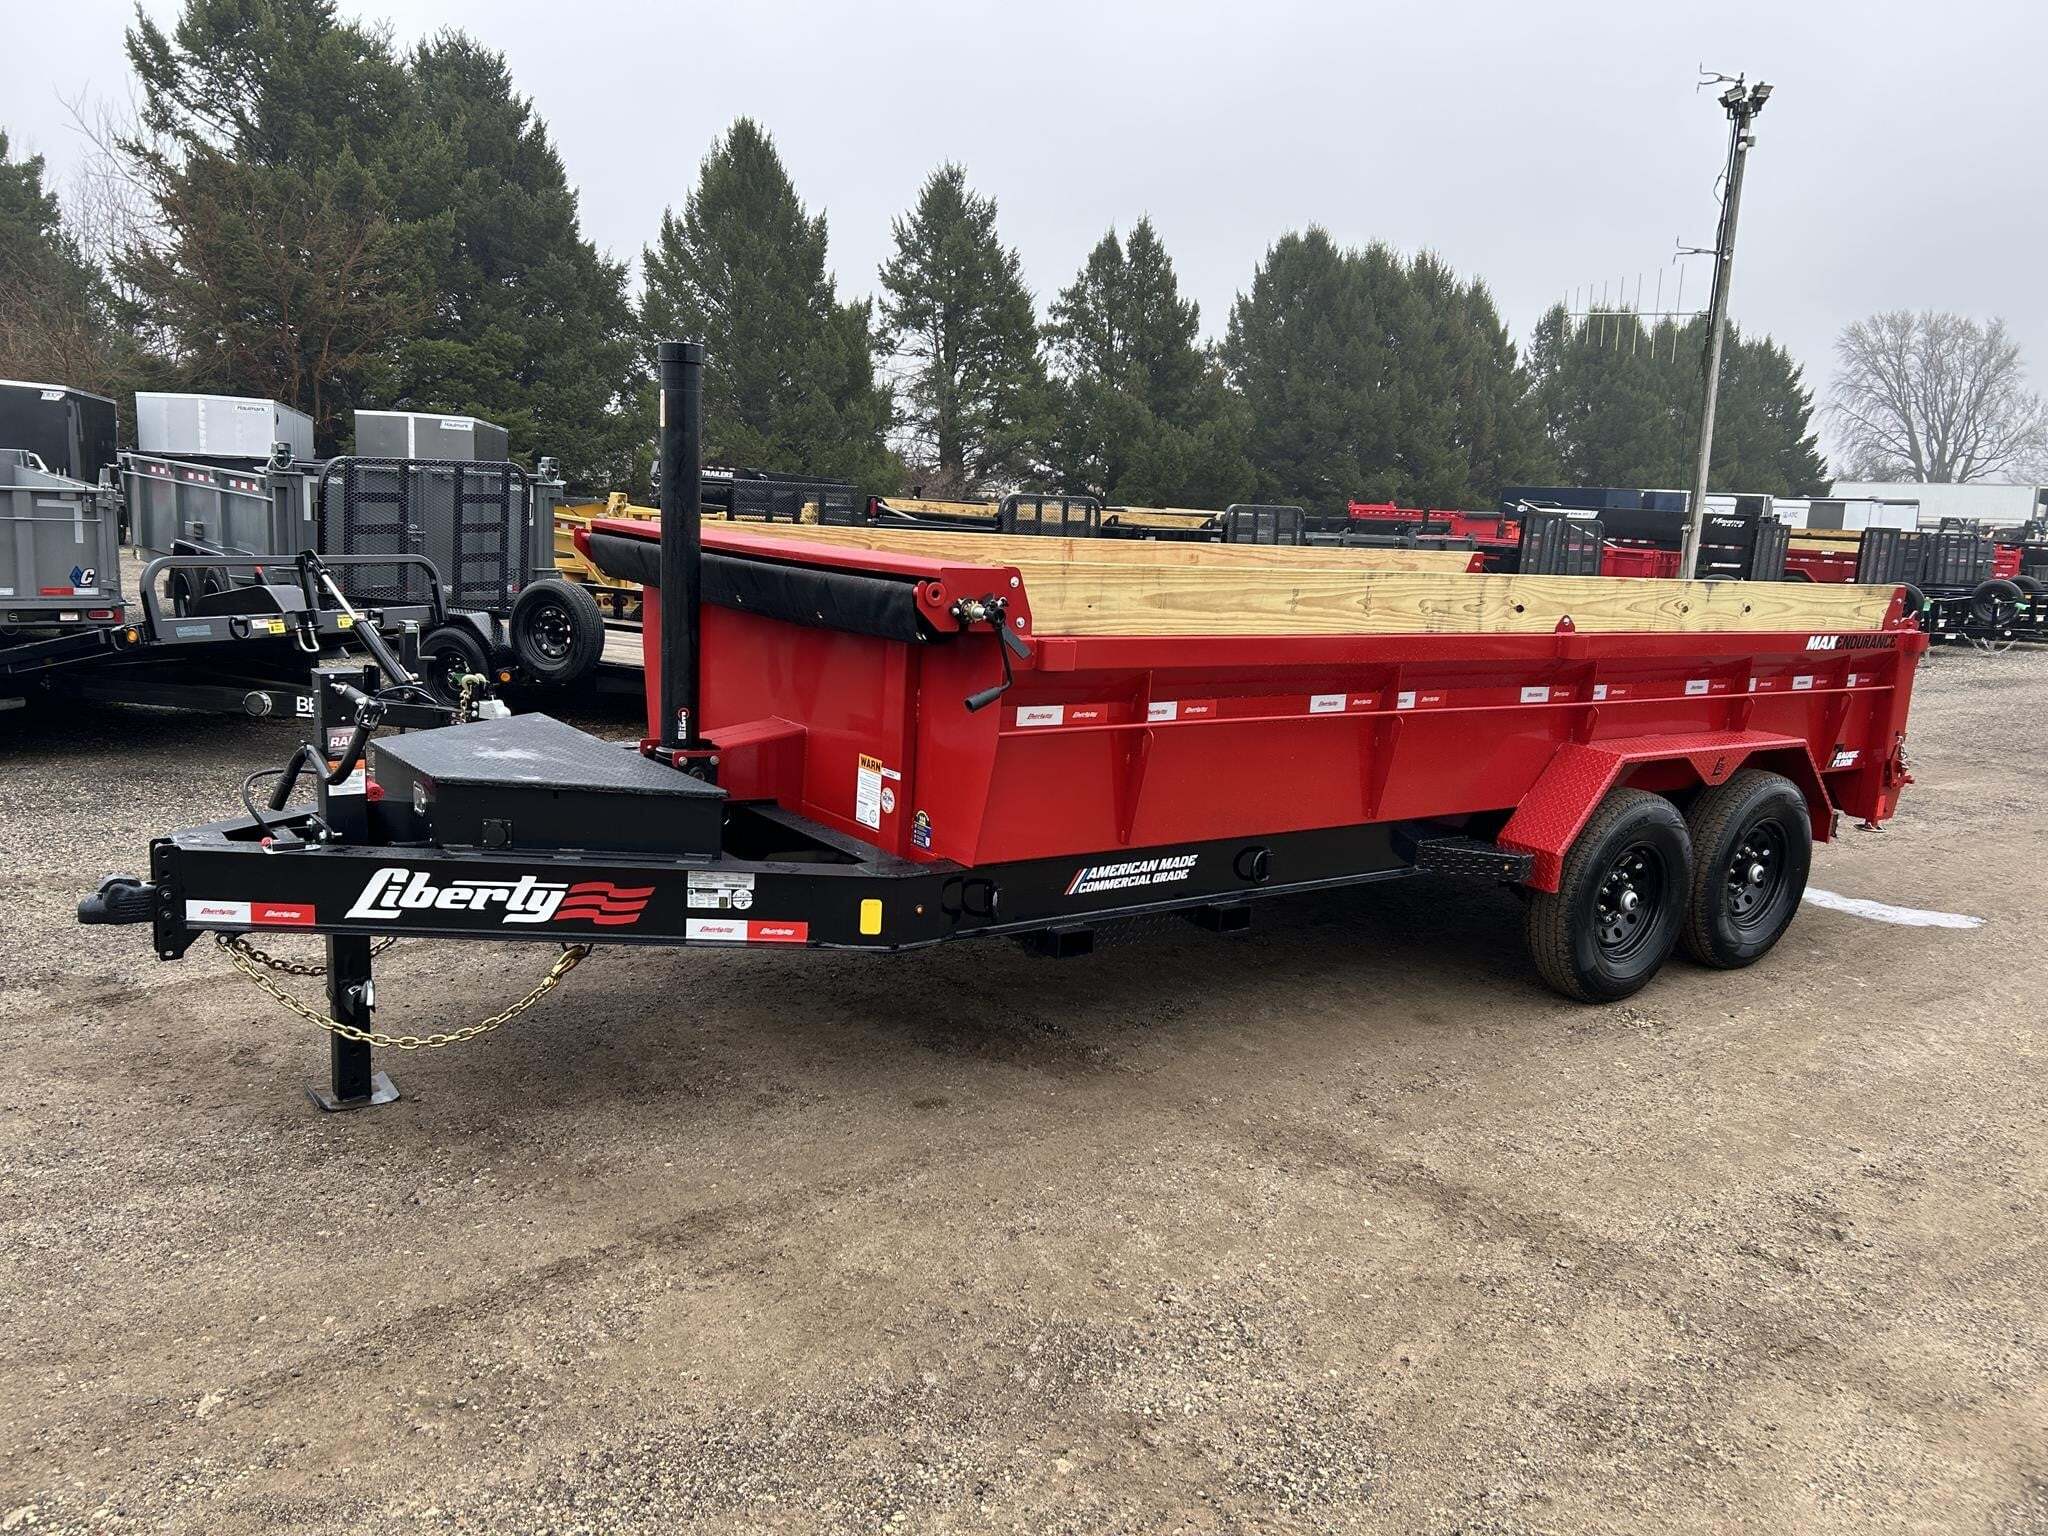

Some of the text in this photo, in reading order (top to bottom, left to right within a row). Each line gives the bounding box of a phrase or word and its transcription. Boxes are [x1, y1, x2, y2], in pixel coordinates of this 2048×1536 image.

[1086, 854, 1199, 880] AMERICAN MADE
[1079, 869, 1190, 893] COMMERCIAL GRADE
[344, 867, 569, 924] Liberty
